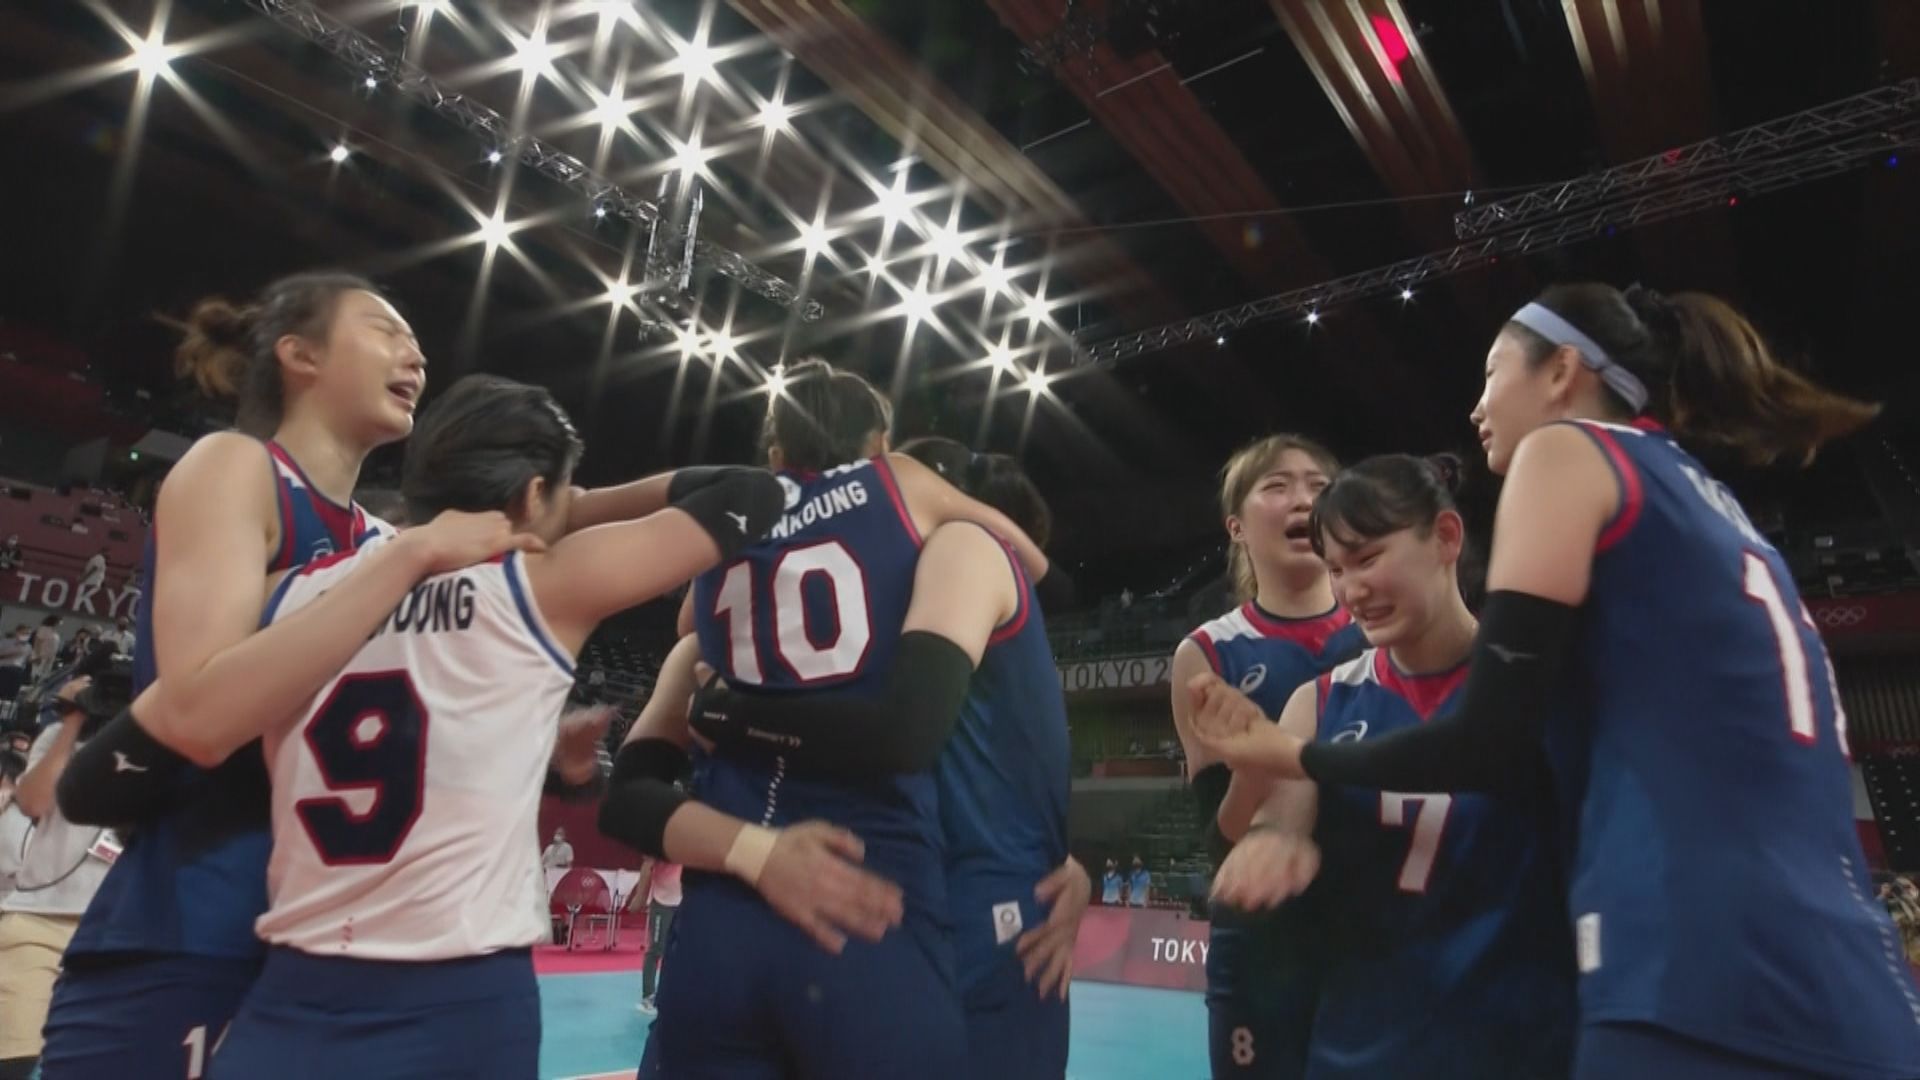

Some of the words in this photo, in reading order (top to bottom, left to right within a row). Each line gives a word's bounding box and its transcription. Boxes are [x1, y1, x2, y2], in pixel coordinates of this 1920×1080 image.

[761, 480, 868, 540] NKOUNG
[377, 576, 475, 634] OUNG
[713, 539, 873, 686] 10
[1057, 661, 1145, 690] TOKYO
[1741, 547, 1852, 763] 1
[295, 668, 429, 867] 9
[1379, 790, 1453, 892] 7
[1151, 937, 1210, 966] TOKY
[1231, 1026, 1255, 1065] 8
